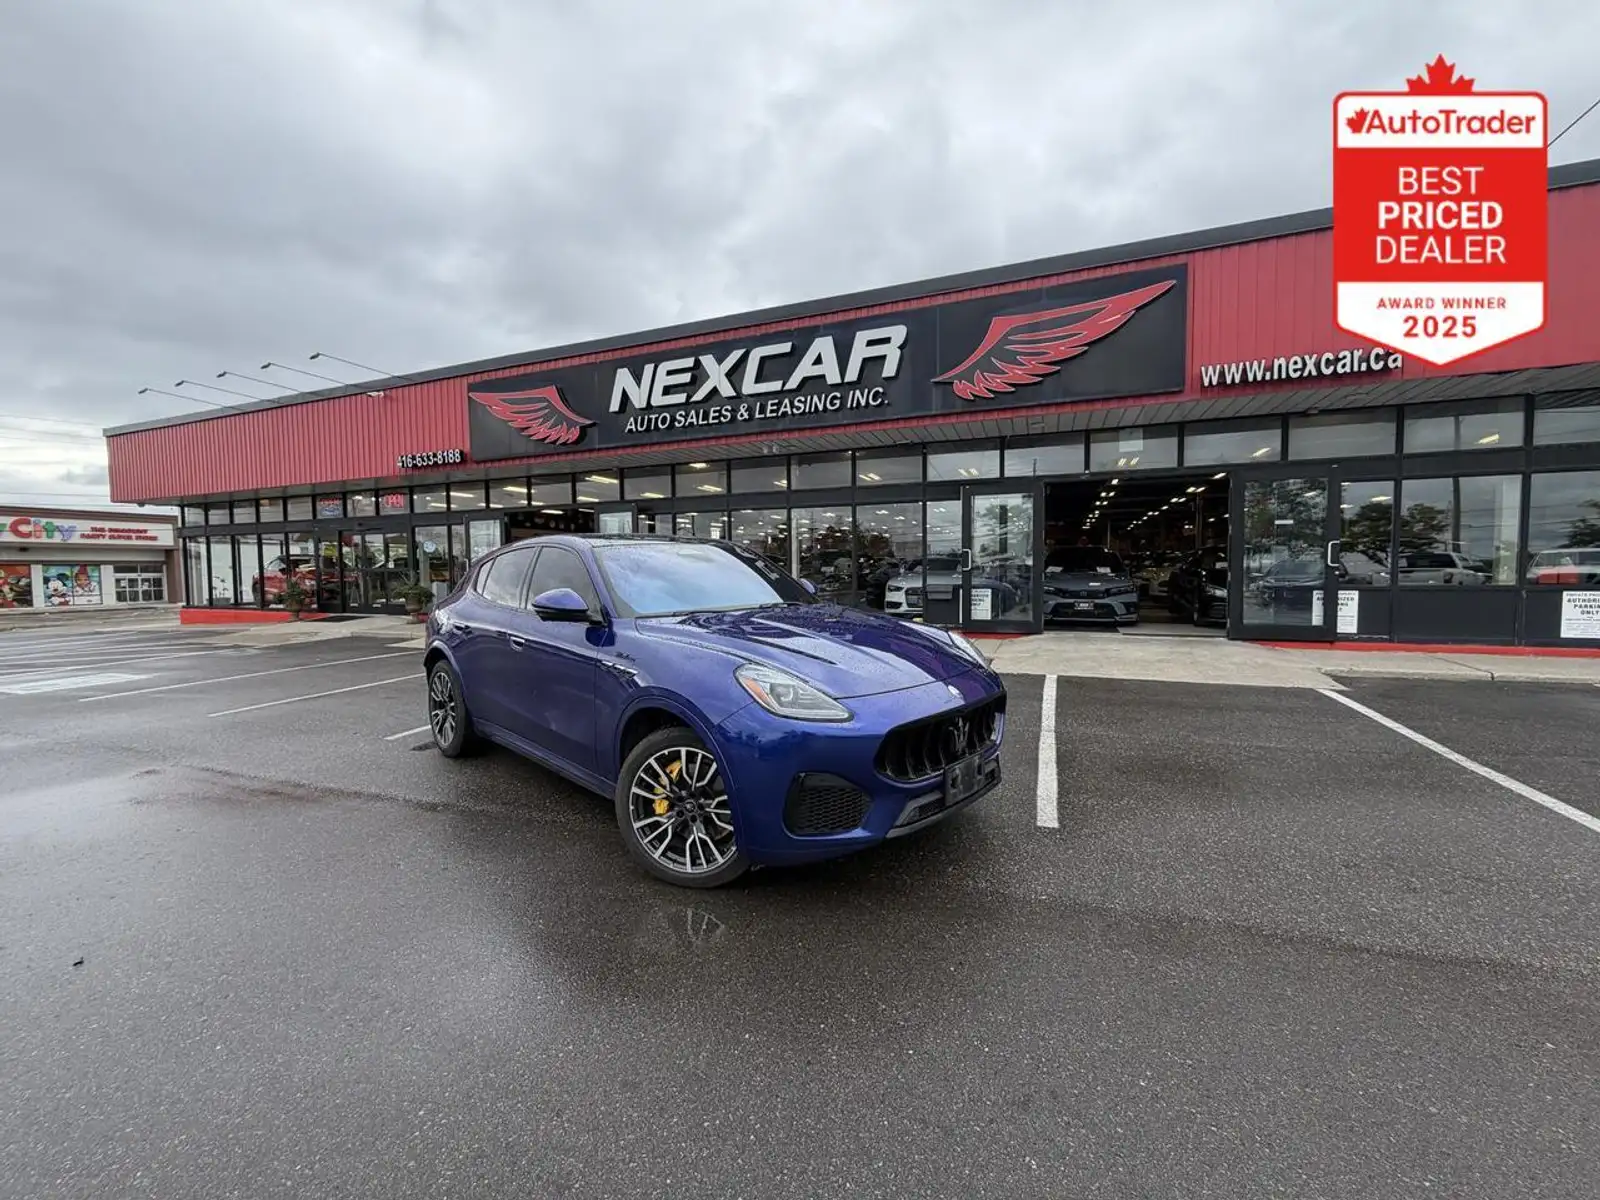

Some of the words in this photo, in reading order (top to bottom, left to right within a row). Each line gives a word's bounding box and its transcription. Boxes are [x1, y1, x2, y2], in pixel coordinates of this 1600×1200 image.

[608, 324, 908, 413] NEXCAR
[1200, 346, 1403, 387] www.nexcar.ca
[625, 412, 671, 433] AUTO
[674, 403, 732, 428] SALES
[737, 404, 750, 420] &
[755, 392, 841, 419] LEASING
[846, 386, 889, 408] INC.
[396, 448, 462, 468] 416-633-8188
[8, 516, 76, 541] City
